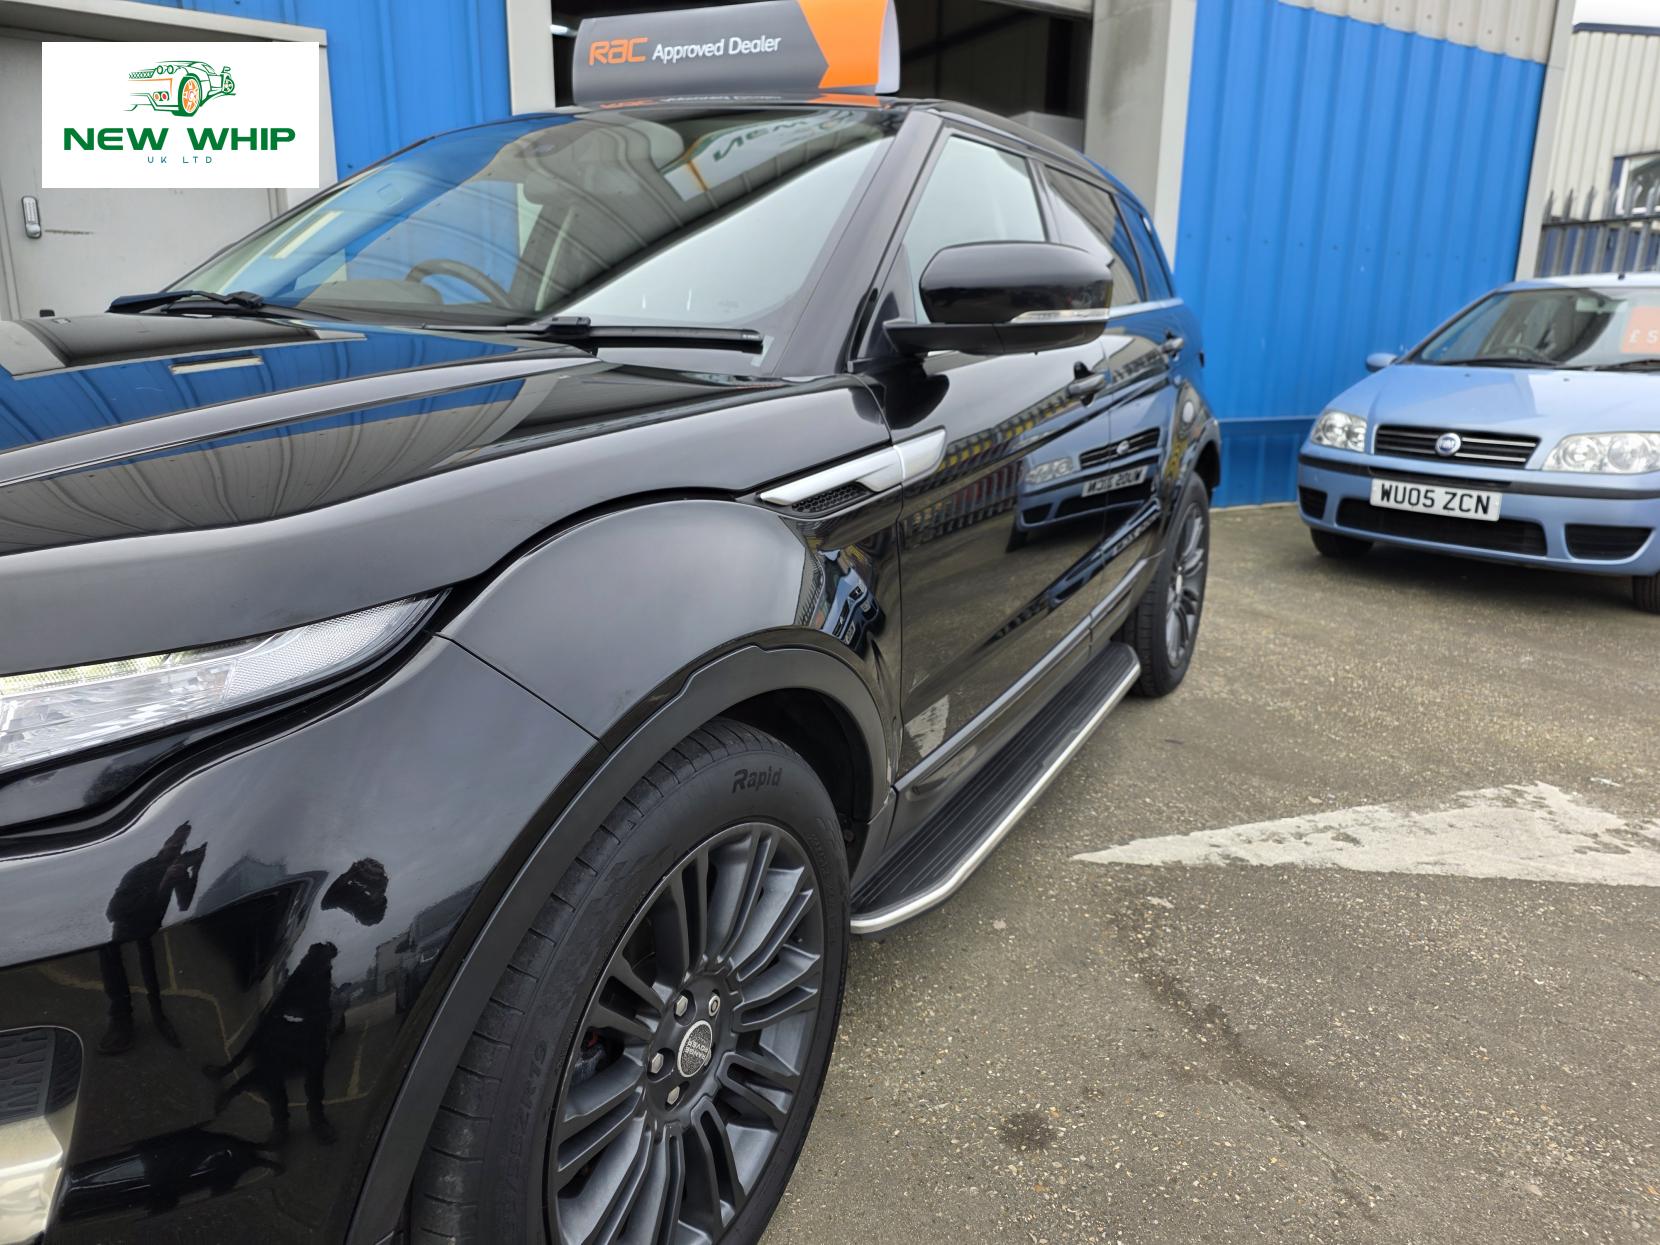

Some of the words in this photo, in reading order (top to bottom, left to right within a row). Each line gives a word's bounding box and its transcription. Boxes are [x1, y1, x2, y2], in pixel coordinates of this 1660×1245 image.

[652, 39, 725, 64] Approved
[728, 35, 782, 55] Dealer
[1380, 483, 1435, 509] WU05
[1442, 491, 1491, 515] ZCN
[731, 765, 783, 794] Rapid
